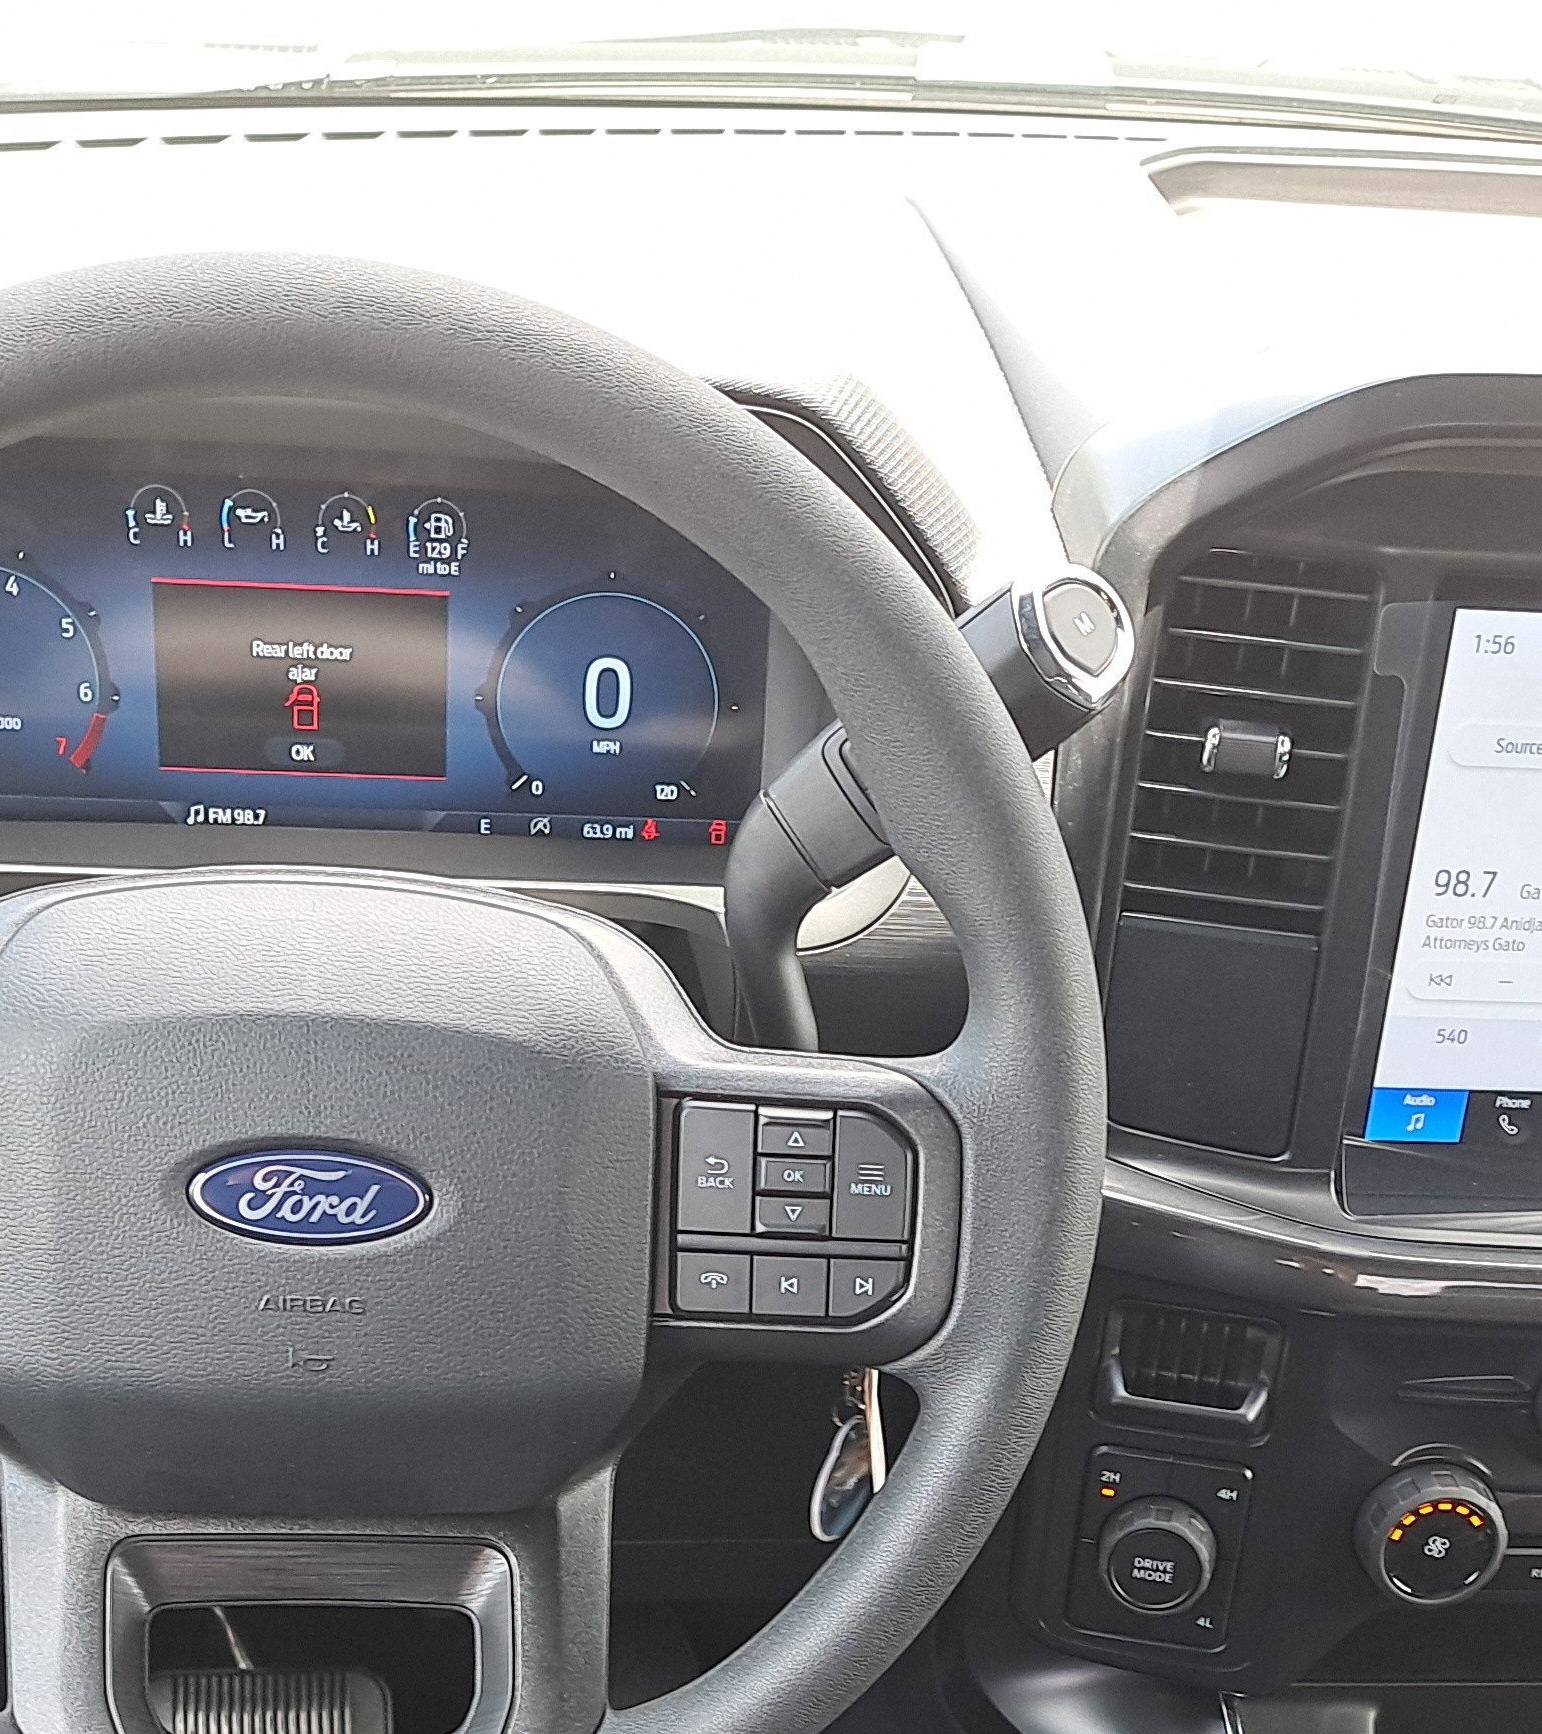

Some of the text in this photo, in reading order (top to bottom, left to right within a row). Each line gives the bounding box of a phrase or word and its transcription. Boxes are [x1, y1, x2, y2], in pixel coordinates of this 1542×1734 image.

[128, 528, 140, 545] C
[178, 530, 192, 547] H
[224, 532, 234, 548] L
[271, 534, 285, 551] H
[316, 538, 329, 554] C
[366, 539, 379, 556] H
[409, 541, 420, 558] E
[425, 542, 451, 558] 129
[457, 542, 469, 559] F
[436, 562, 449, 576] to
[450, 562, 460, 576] E
[5, 576, 19, 596] 4
[61, 619, 75, 638] 5
[252, 640, 352, 661] Rear left door
[1473, 634, 1516, 656] 1:56
[288, 664, 318, 684] ajar
[79, 683, 93, 702] 6
[584, 657, 633, 729] 0
[56, 738, 67, 755] 7
[290, 744, 316, 762] OK
[592, 740, 620, 756] MPH
[530, 780, 543, 795] 0
[655, 785, 677, 800] 120
[208, 809, 266, 825] FM 98.7
[480, 819, 491, 834] E
[582, 823, 634, 840] 63.9 mi
[1433, 869, 1498, 899] 98.7
[1426, 914, 1465, 930] Gator
[1467, 915, 1497, 930] 98.7
[1422, 936, 1490, 953] Attorneys
[1435, 1028, 1468, 1045] 540
[1494, 1095, 1533, 1110] Phone
[697, 1176, 734, 1188] BACK
[783, 1170, 803, 1182] OK
[238, 1165, 381, 1225] Ford
[850, 1183, 891, 1196] MENU
[258, 1294, 365, 1314] AIRBAG
[1100, 1470, 1121, 1484] 2H
[1216, 1488, 1238, 1501] 4H
[1134, 1557, 1175, 1573] DRIVE
[1131, 1569, 1174, 1584] MODE
[1195, 1617, 1213, 1629] 4L
